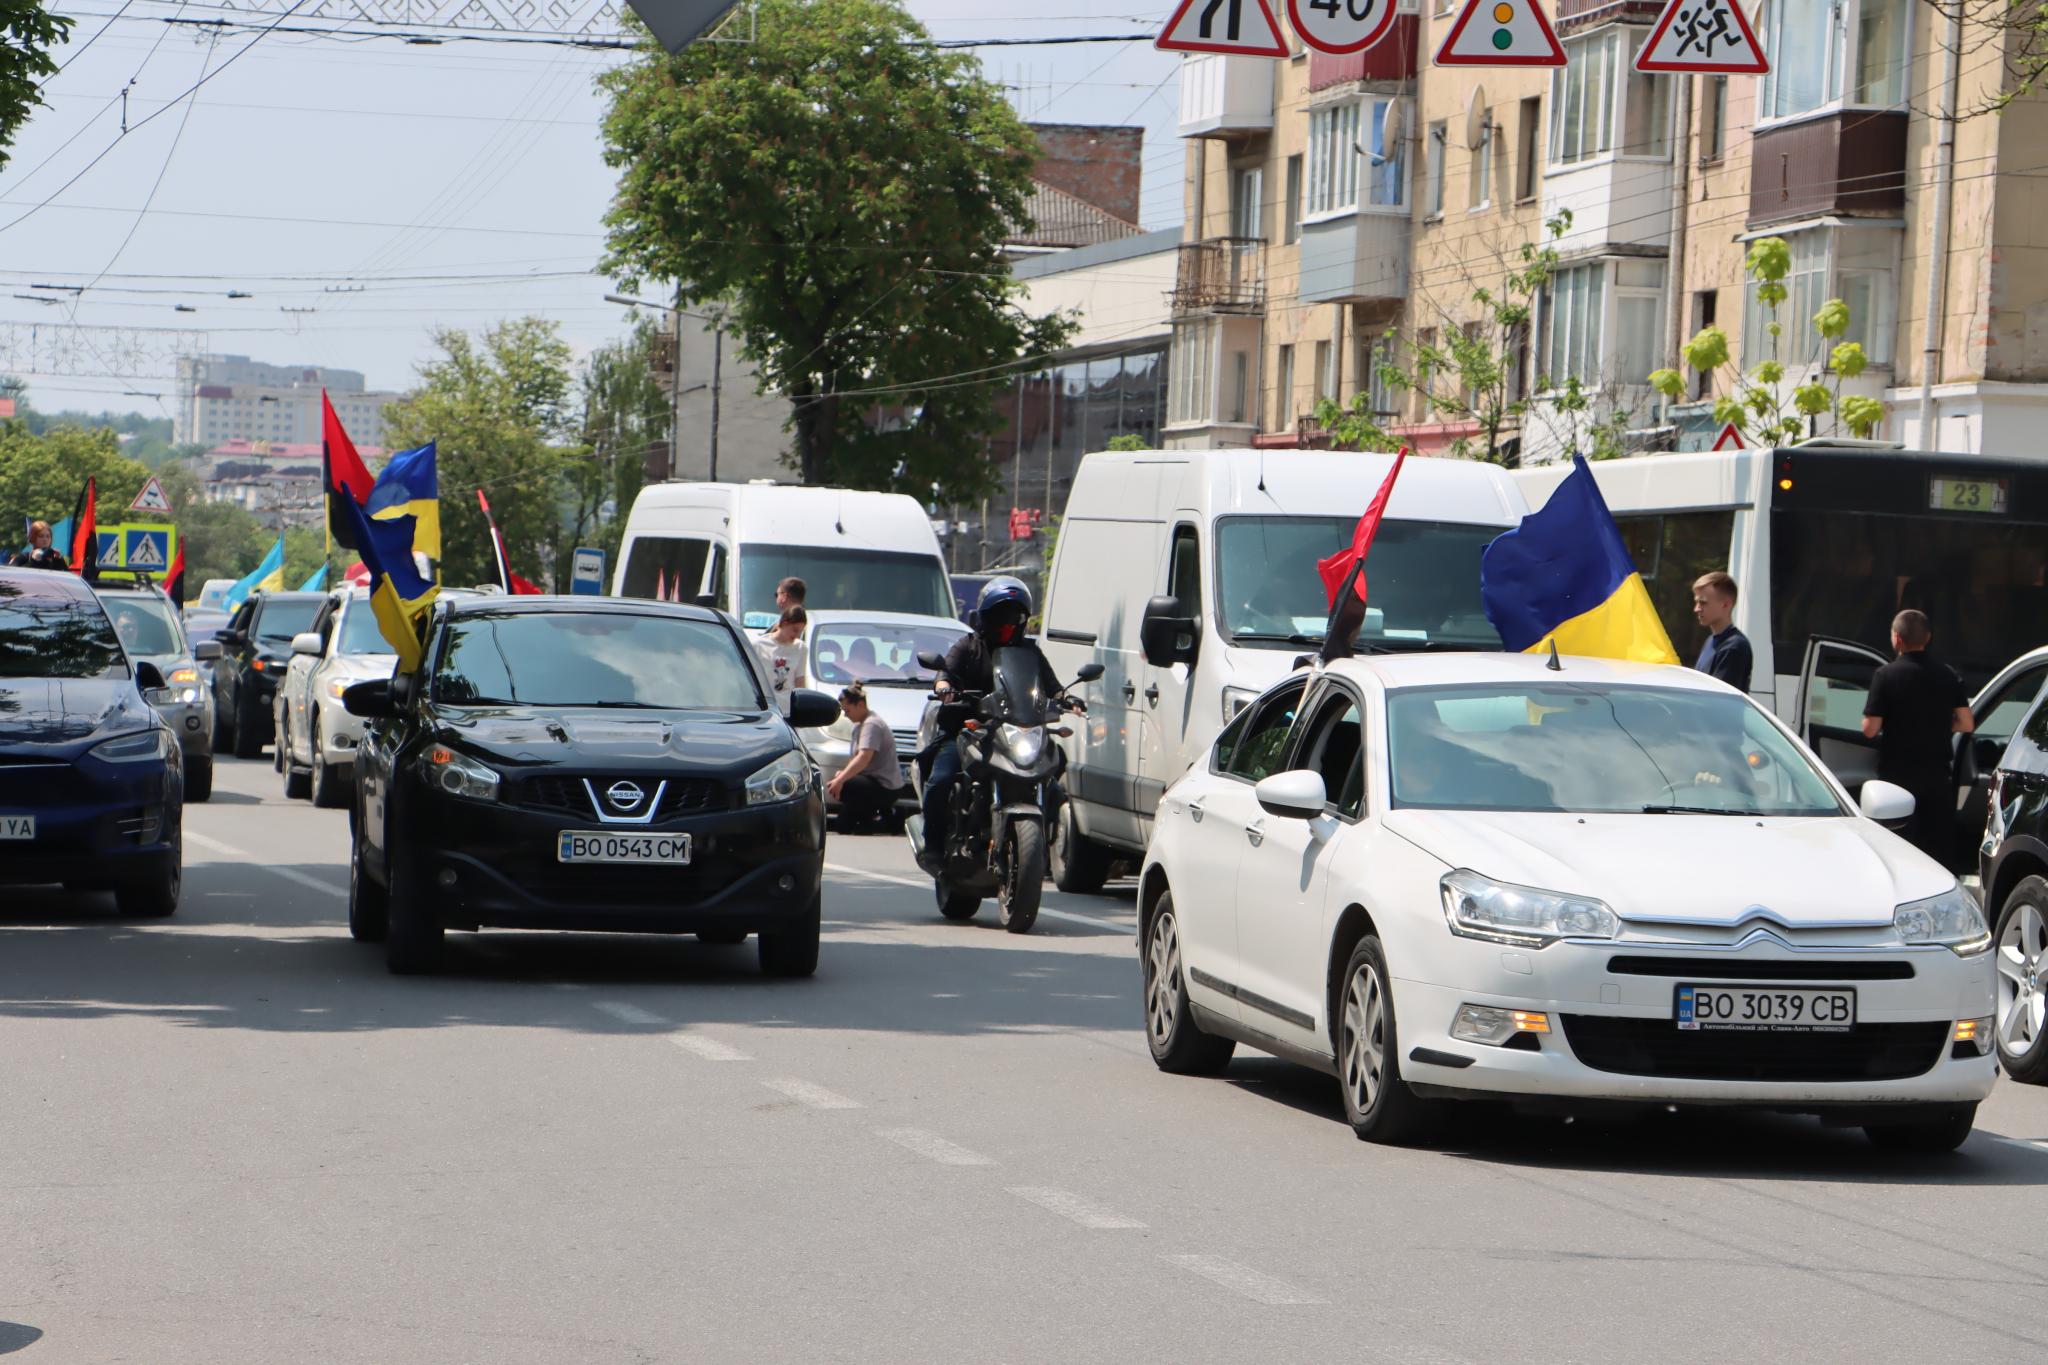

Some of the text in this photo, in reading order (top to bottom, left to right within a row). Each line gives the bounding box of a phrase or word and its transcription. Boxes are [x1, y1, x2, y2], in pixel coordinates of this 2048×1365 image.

[1953, 483, 1981, 506] 23
[7, 819, 32, 836] YA
[573, 837, 686, 859] BO 0543 CM
[1680, 1010, 1692, 1018] UA
[1694, 992, 1849, 1021] BO 3039 CB
